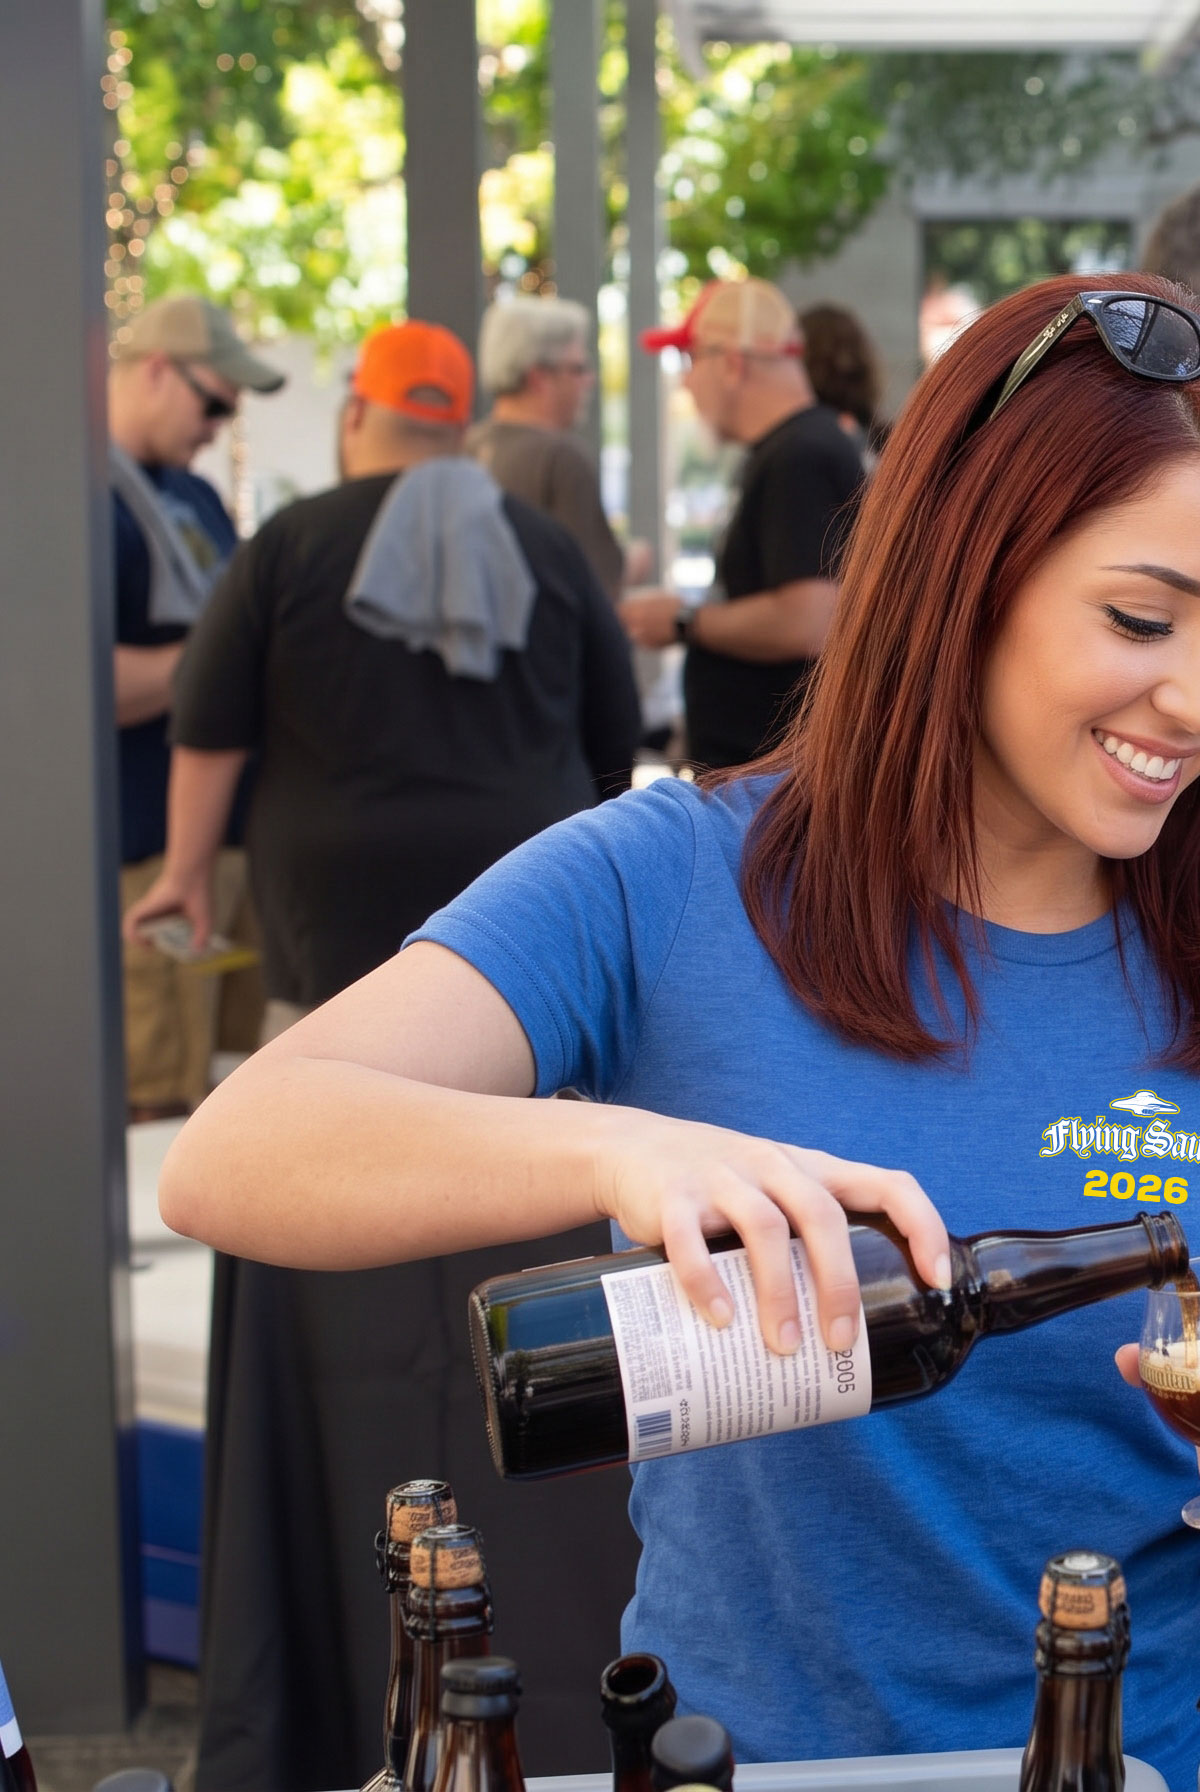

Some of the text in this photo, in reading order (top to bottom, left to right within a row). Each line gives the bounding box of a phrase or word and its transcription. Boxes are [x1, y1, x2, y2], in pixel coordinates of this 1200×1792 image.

[1039, 1116, 1142, 1162] Flying
[1083, 1169, 1189, 1205] 2026
[834, 1348, 856, 1394] 2005
